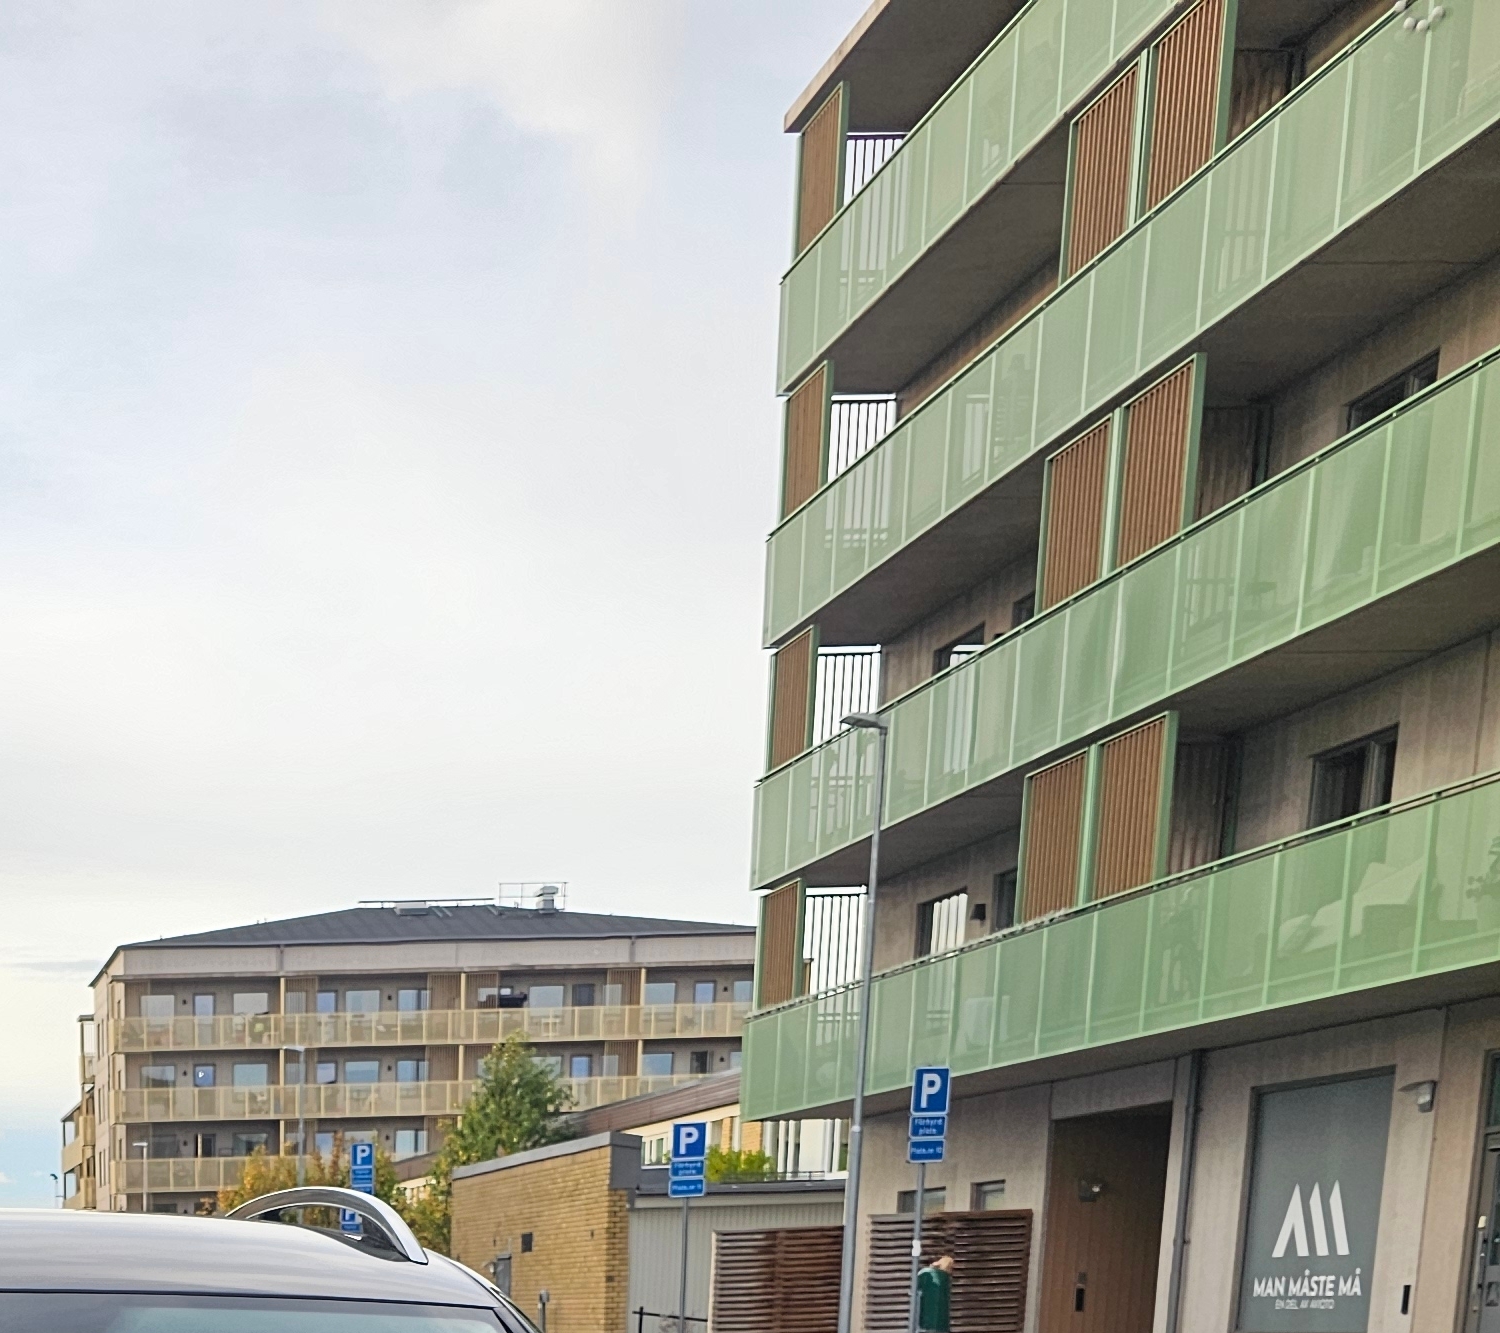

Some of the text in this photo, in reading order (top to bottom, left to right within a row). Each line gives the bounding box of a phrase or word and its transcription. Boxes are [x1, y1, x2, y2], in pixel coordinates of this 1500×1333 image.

[920, 1073, 942, 1109] P
[356, 1145, 371, 1165] P
[679, 1126, 699, 1155] P
[1253, 1267, 1362, 1297] MAN MÅSTE MÅ
